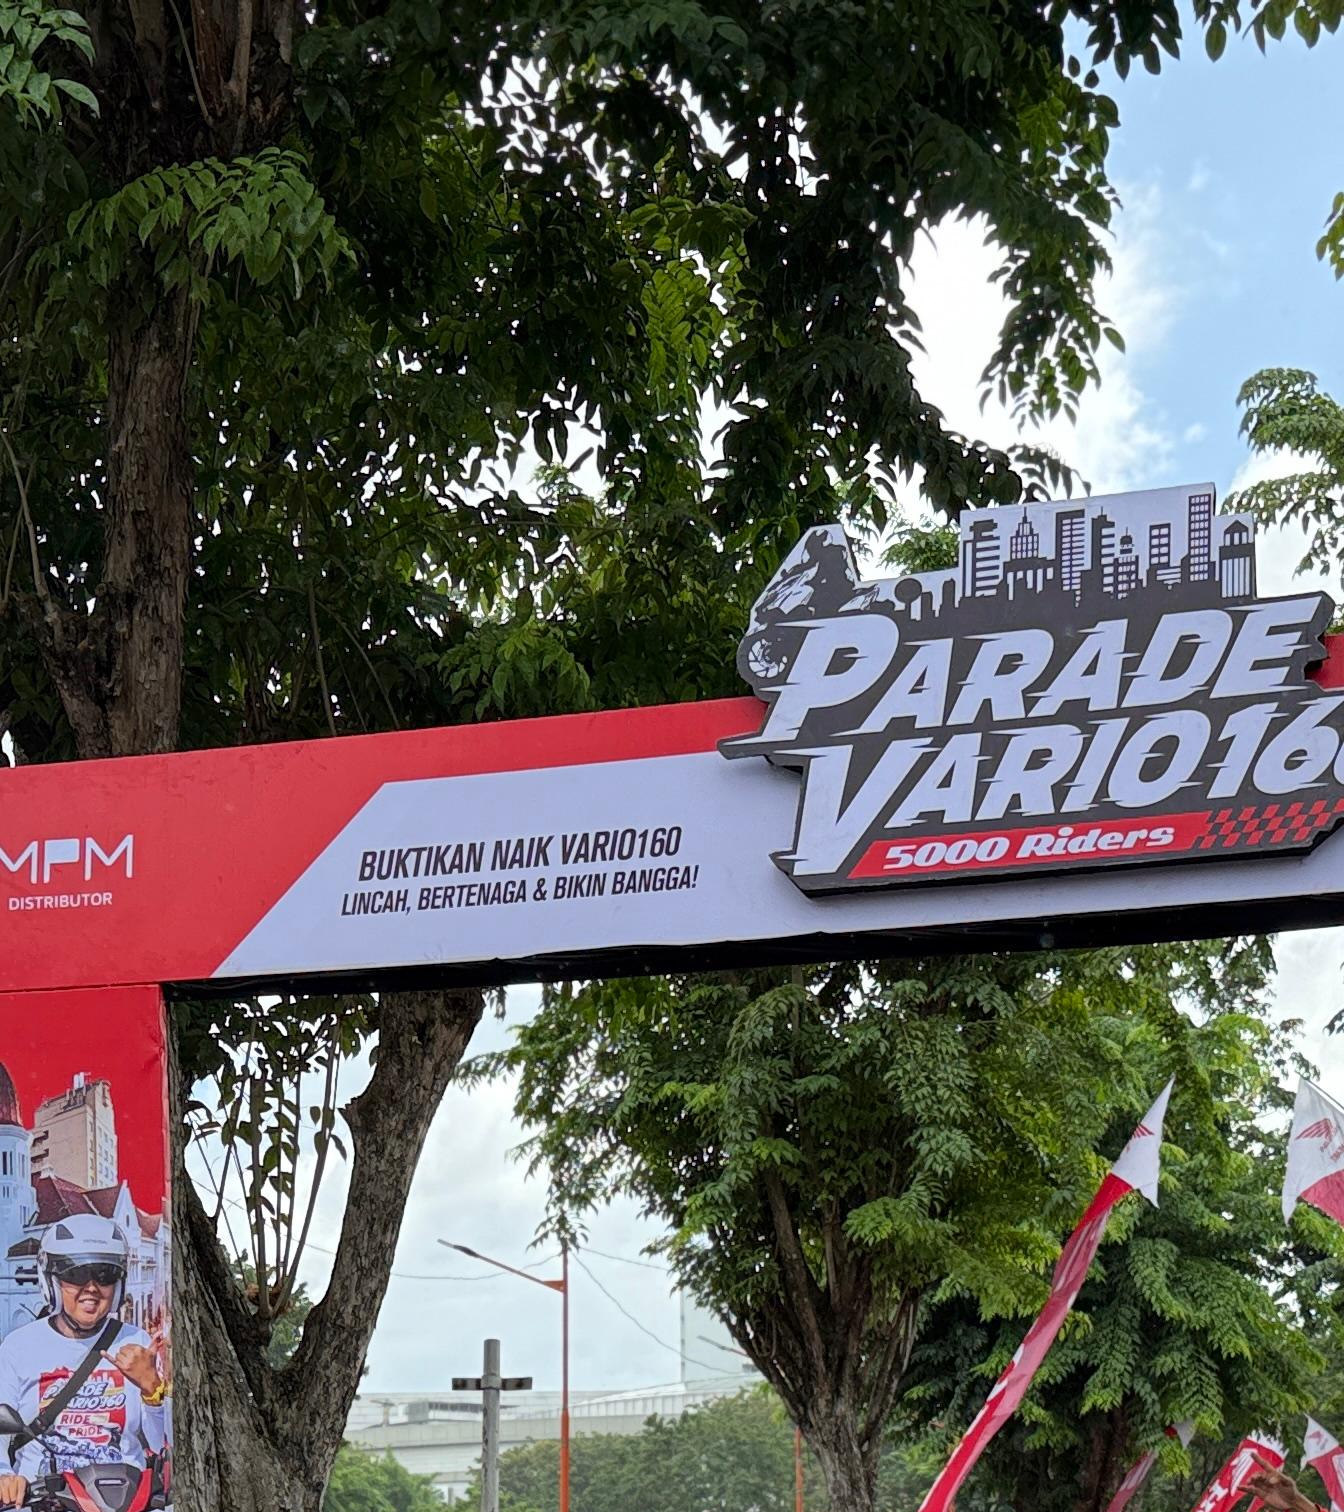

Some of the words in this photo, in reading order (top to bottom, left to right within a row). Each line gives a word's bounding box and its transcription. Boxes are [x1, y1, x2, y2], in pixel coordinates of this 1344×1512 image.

[719, 598, 1330, 746] PARADE
[358, 842, 484, 882] BUKTIKAN
[490, 835, 555, 871] NAIK
[560, 826, 683, 865] VARIO160
[883, 837, 1008, 870] 5000
[1016, 824, 1175, 860] Riders
[8, 892, 113, 911] DISTRIBUTOR
[341, 889, 412, 917] LINCAH,
[417, 880, 528, 911] BERTENAGA
[533, 877, 549, 901] &
[553, 872, 607, 900] BIKIN
[611, 865, 700, 896] BANGGA!
[59, 1413, 93, 1425] RIDE
[68, 1426, 103, 1438] PRIDE
